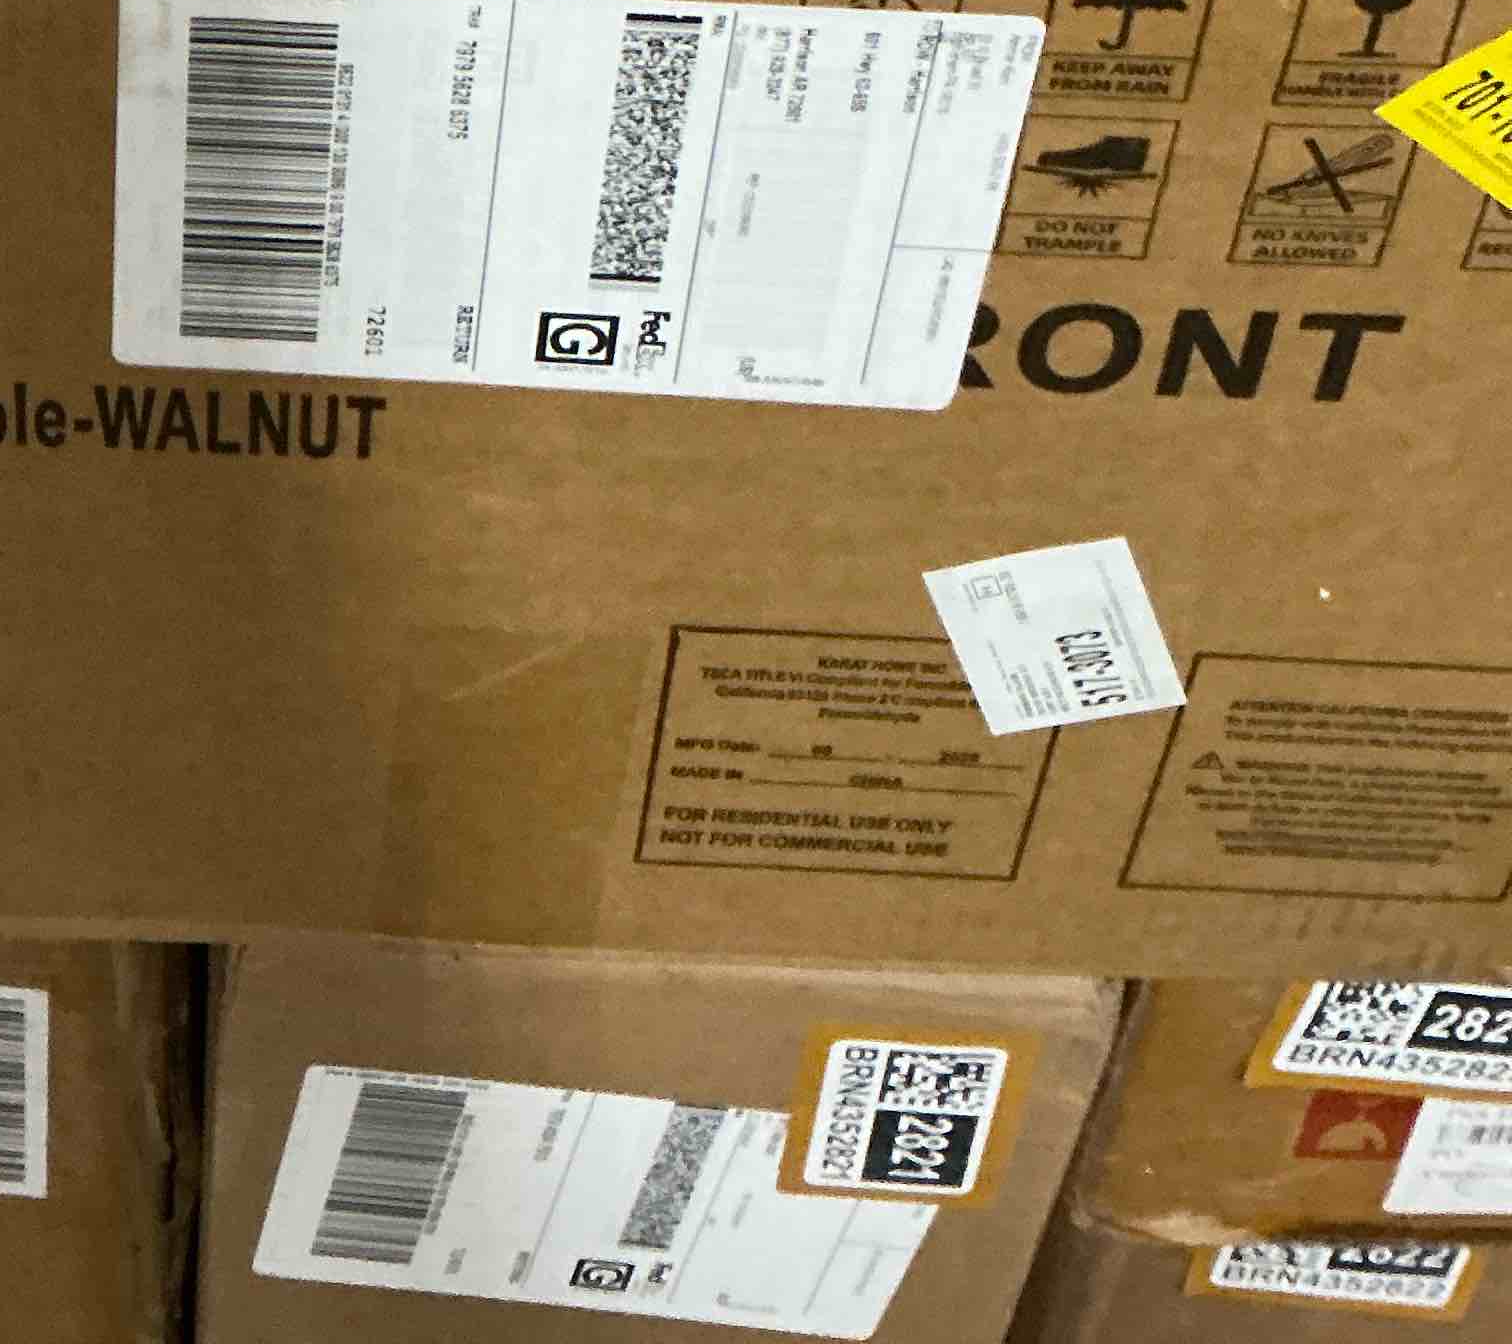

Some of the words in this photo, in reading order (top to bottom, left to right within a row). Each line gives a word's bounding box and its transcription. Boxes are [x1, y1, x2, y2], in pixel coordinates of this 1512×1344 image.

[1053, 61, 1108, 76] KEEP
[1112, 63, 1175, 78] AWAY
[365, 304, 387, 356] 72601
[958, 303, 1406, 402] RONT
[1422, 1002, 1512, 1044] 282
[1290, 1042, 1512, 1083] BRN435282
[821, 1046, 879, 1180] BRN4352821
[887, 1114, 954, 1181] 2821
